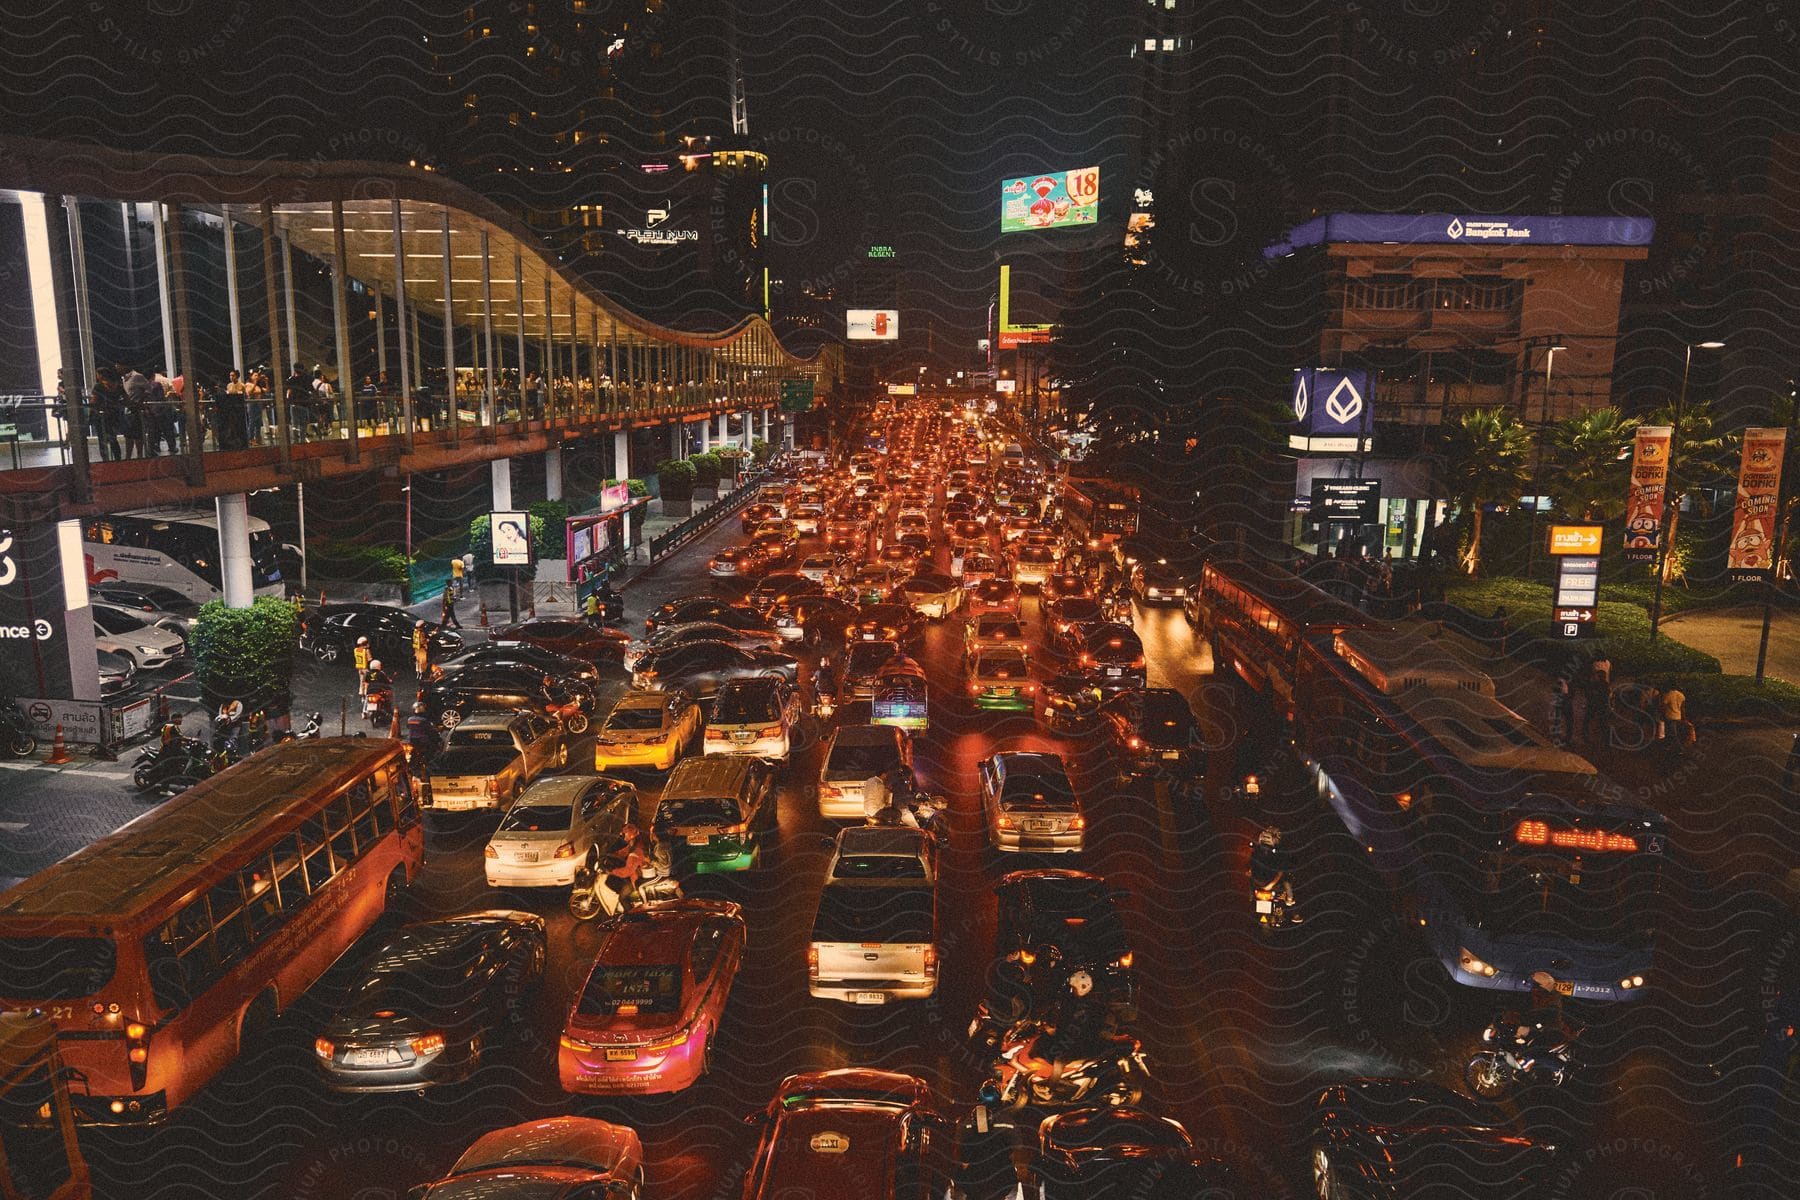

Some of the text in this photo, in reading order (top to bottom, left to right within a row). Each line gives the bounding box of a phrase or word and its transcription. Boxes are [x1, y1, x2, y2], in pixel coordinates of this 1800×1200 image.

[1073, 173, 1097, 197] 18
[1465, 228, 1531, 239] Bangkok Bank
[1742, 479, 1776, 488] DONKI
[1634, 484, 1664, 497] COMING
[1640, 494, 1658, 502] SOON
[1741, 495, 1776, 509] COMING
[1747, 505, 1769, 515] SOON
[1518, 821, 1546, 842] A3
[821, 1139, 838, 1148] TAXI
